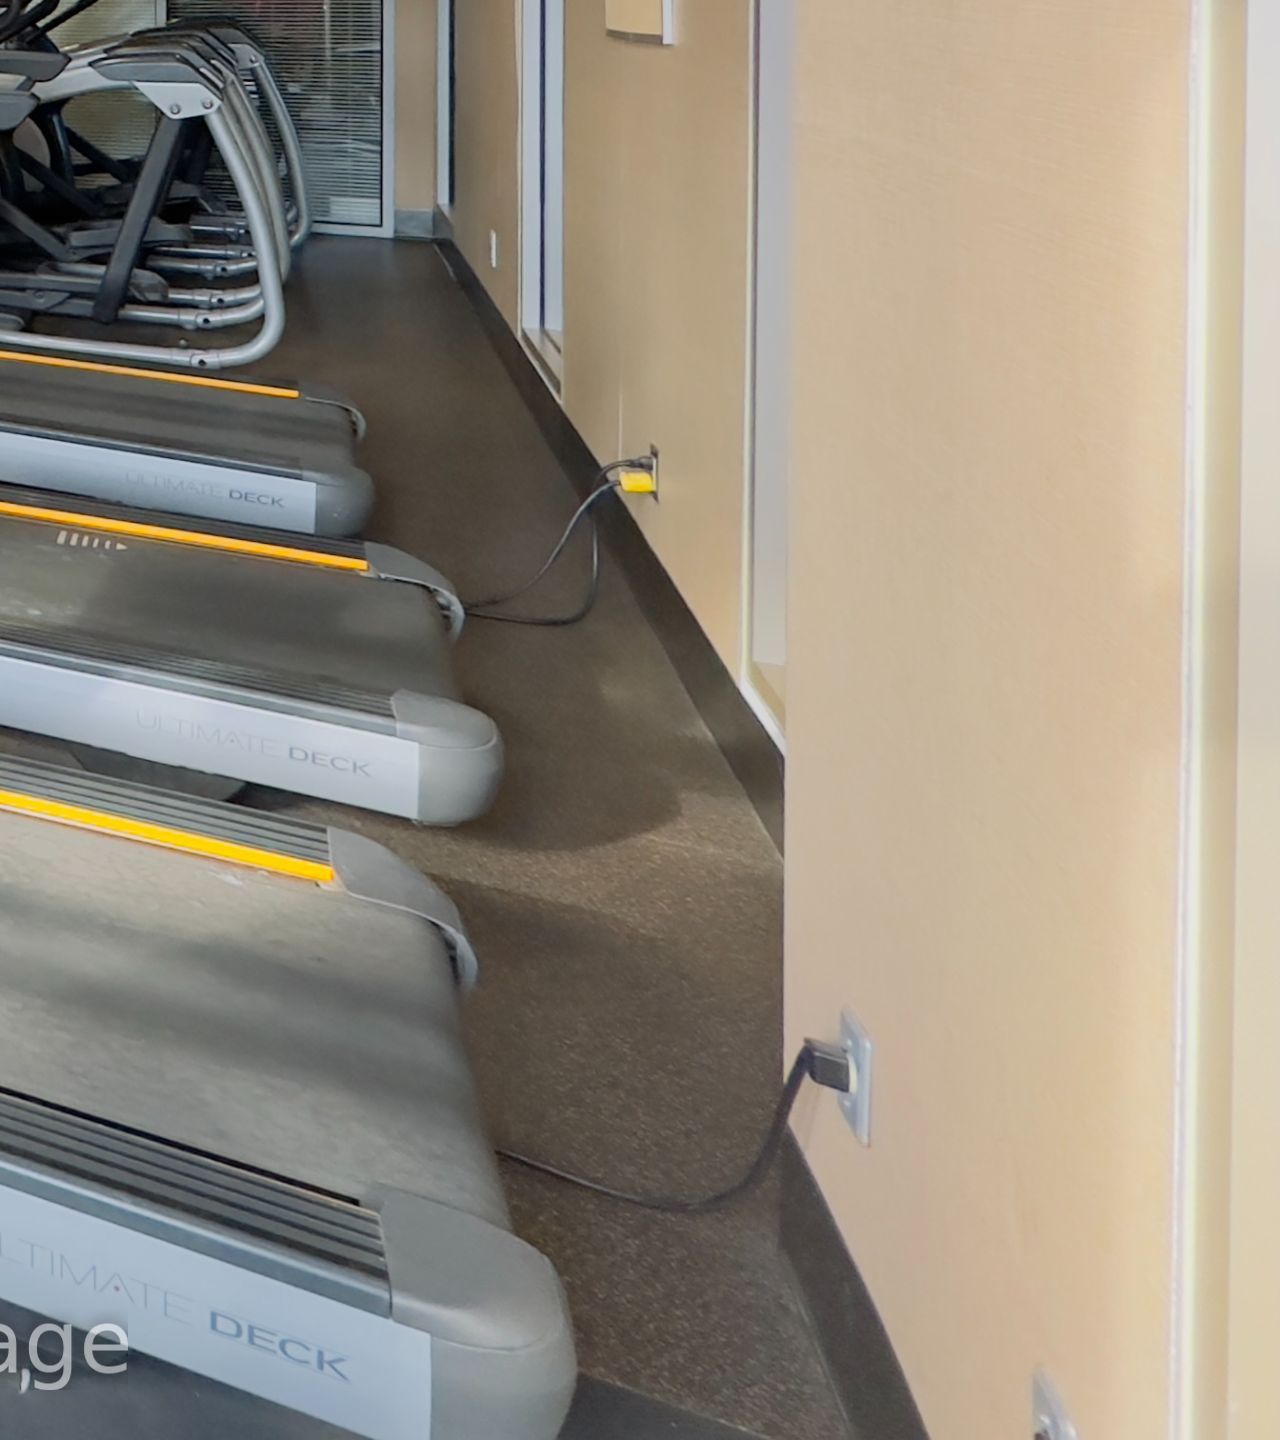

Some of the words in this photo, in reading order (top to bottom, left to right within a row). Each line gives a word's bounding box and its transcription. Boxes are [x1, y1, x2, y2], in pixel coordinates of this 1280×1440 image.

[125, 471, 222, 498] ULTIMATE
[228, 488, 285, 508] DECK
[136, 710, 283, 757] ULTIMATE
[288, 746, 372, 777] DECK
[209, 1308, 351, 1383] DECK
